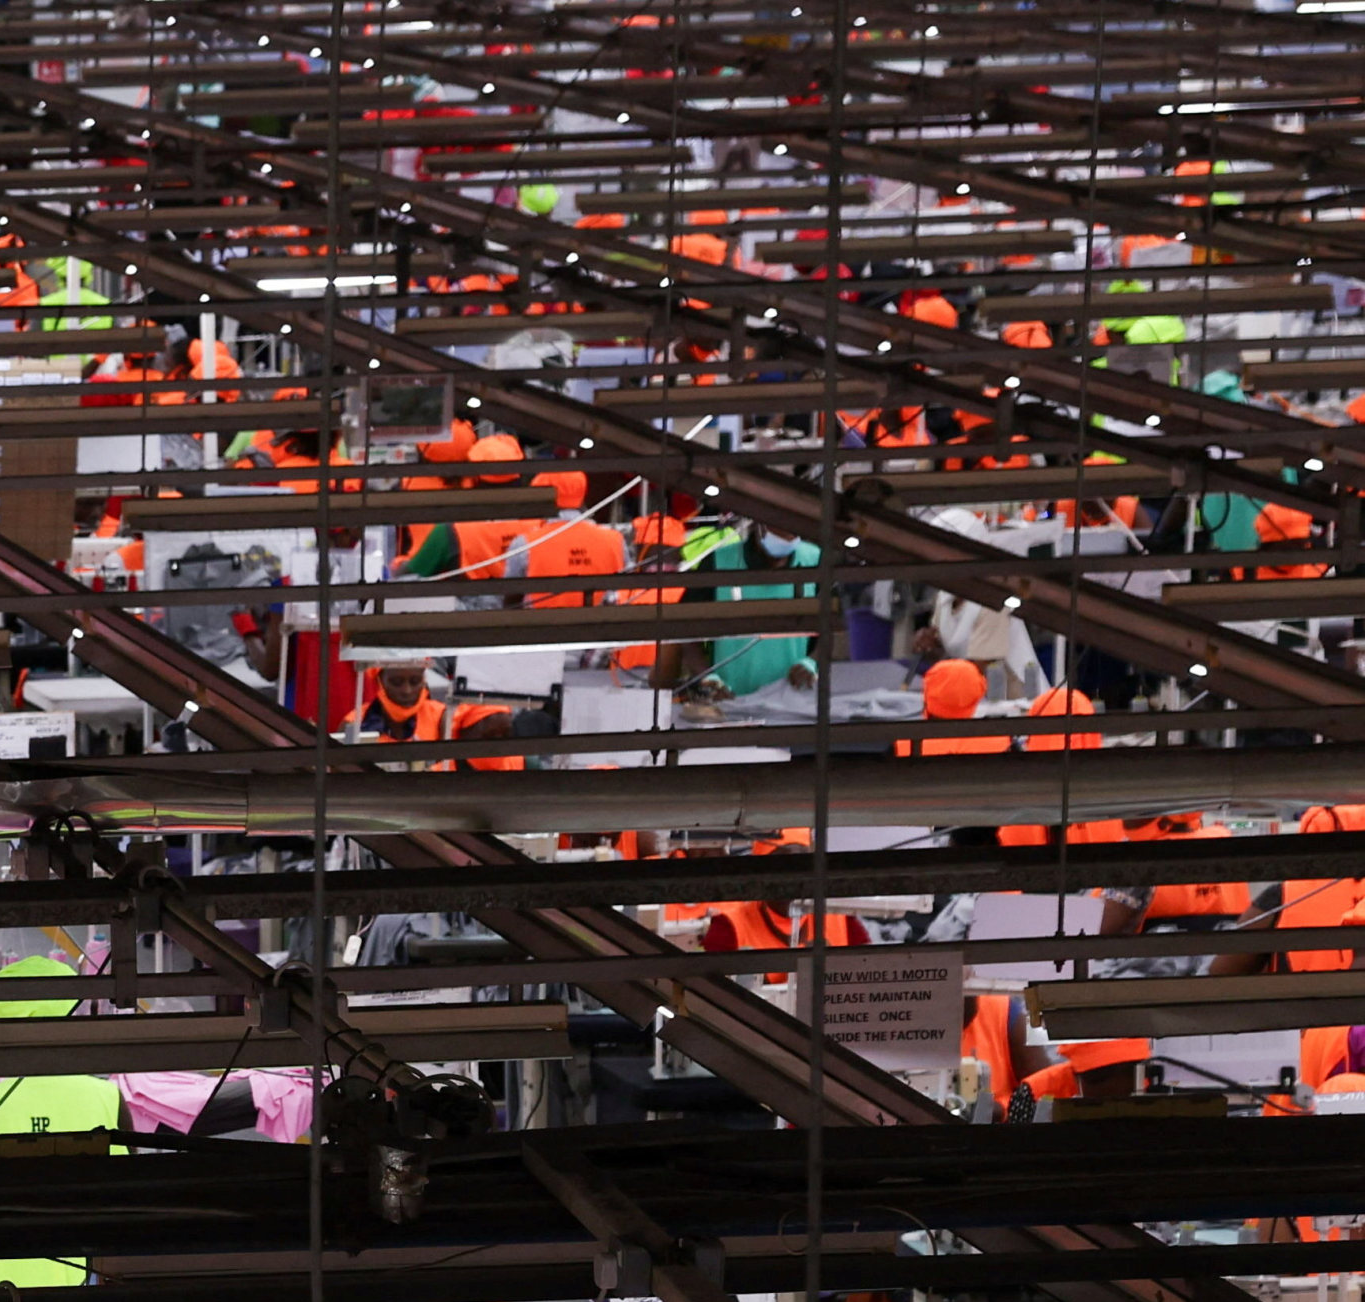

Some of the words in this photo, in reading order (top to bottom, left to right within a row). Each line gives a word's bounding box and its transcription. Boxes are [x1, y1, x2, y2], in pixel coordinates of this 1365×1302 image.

[824, 972, 852, 983] NEW
[856, 971, 889, 982] WIDE
[892, 970, 899, 981] 1
[902, 968, 948, 980] MOTTO
[824, 993, 866, 1004] PLEASE
[869, 990, 932, 1002] MAINTAIN
[823, 1012, 869, 1024] SILENCE
[879, 1011, 912, 1022] ONCE
[826, 1032, 861, 1042] NSIDE
[864, 1031, 887, 1041] THE
[890, 1029, 946, 1041] FACTORY
